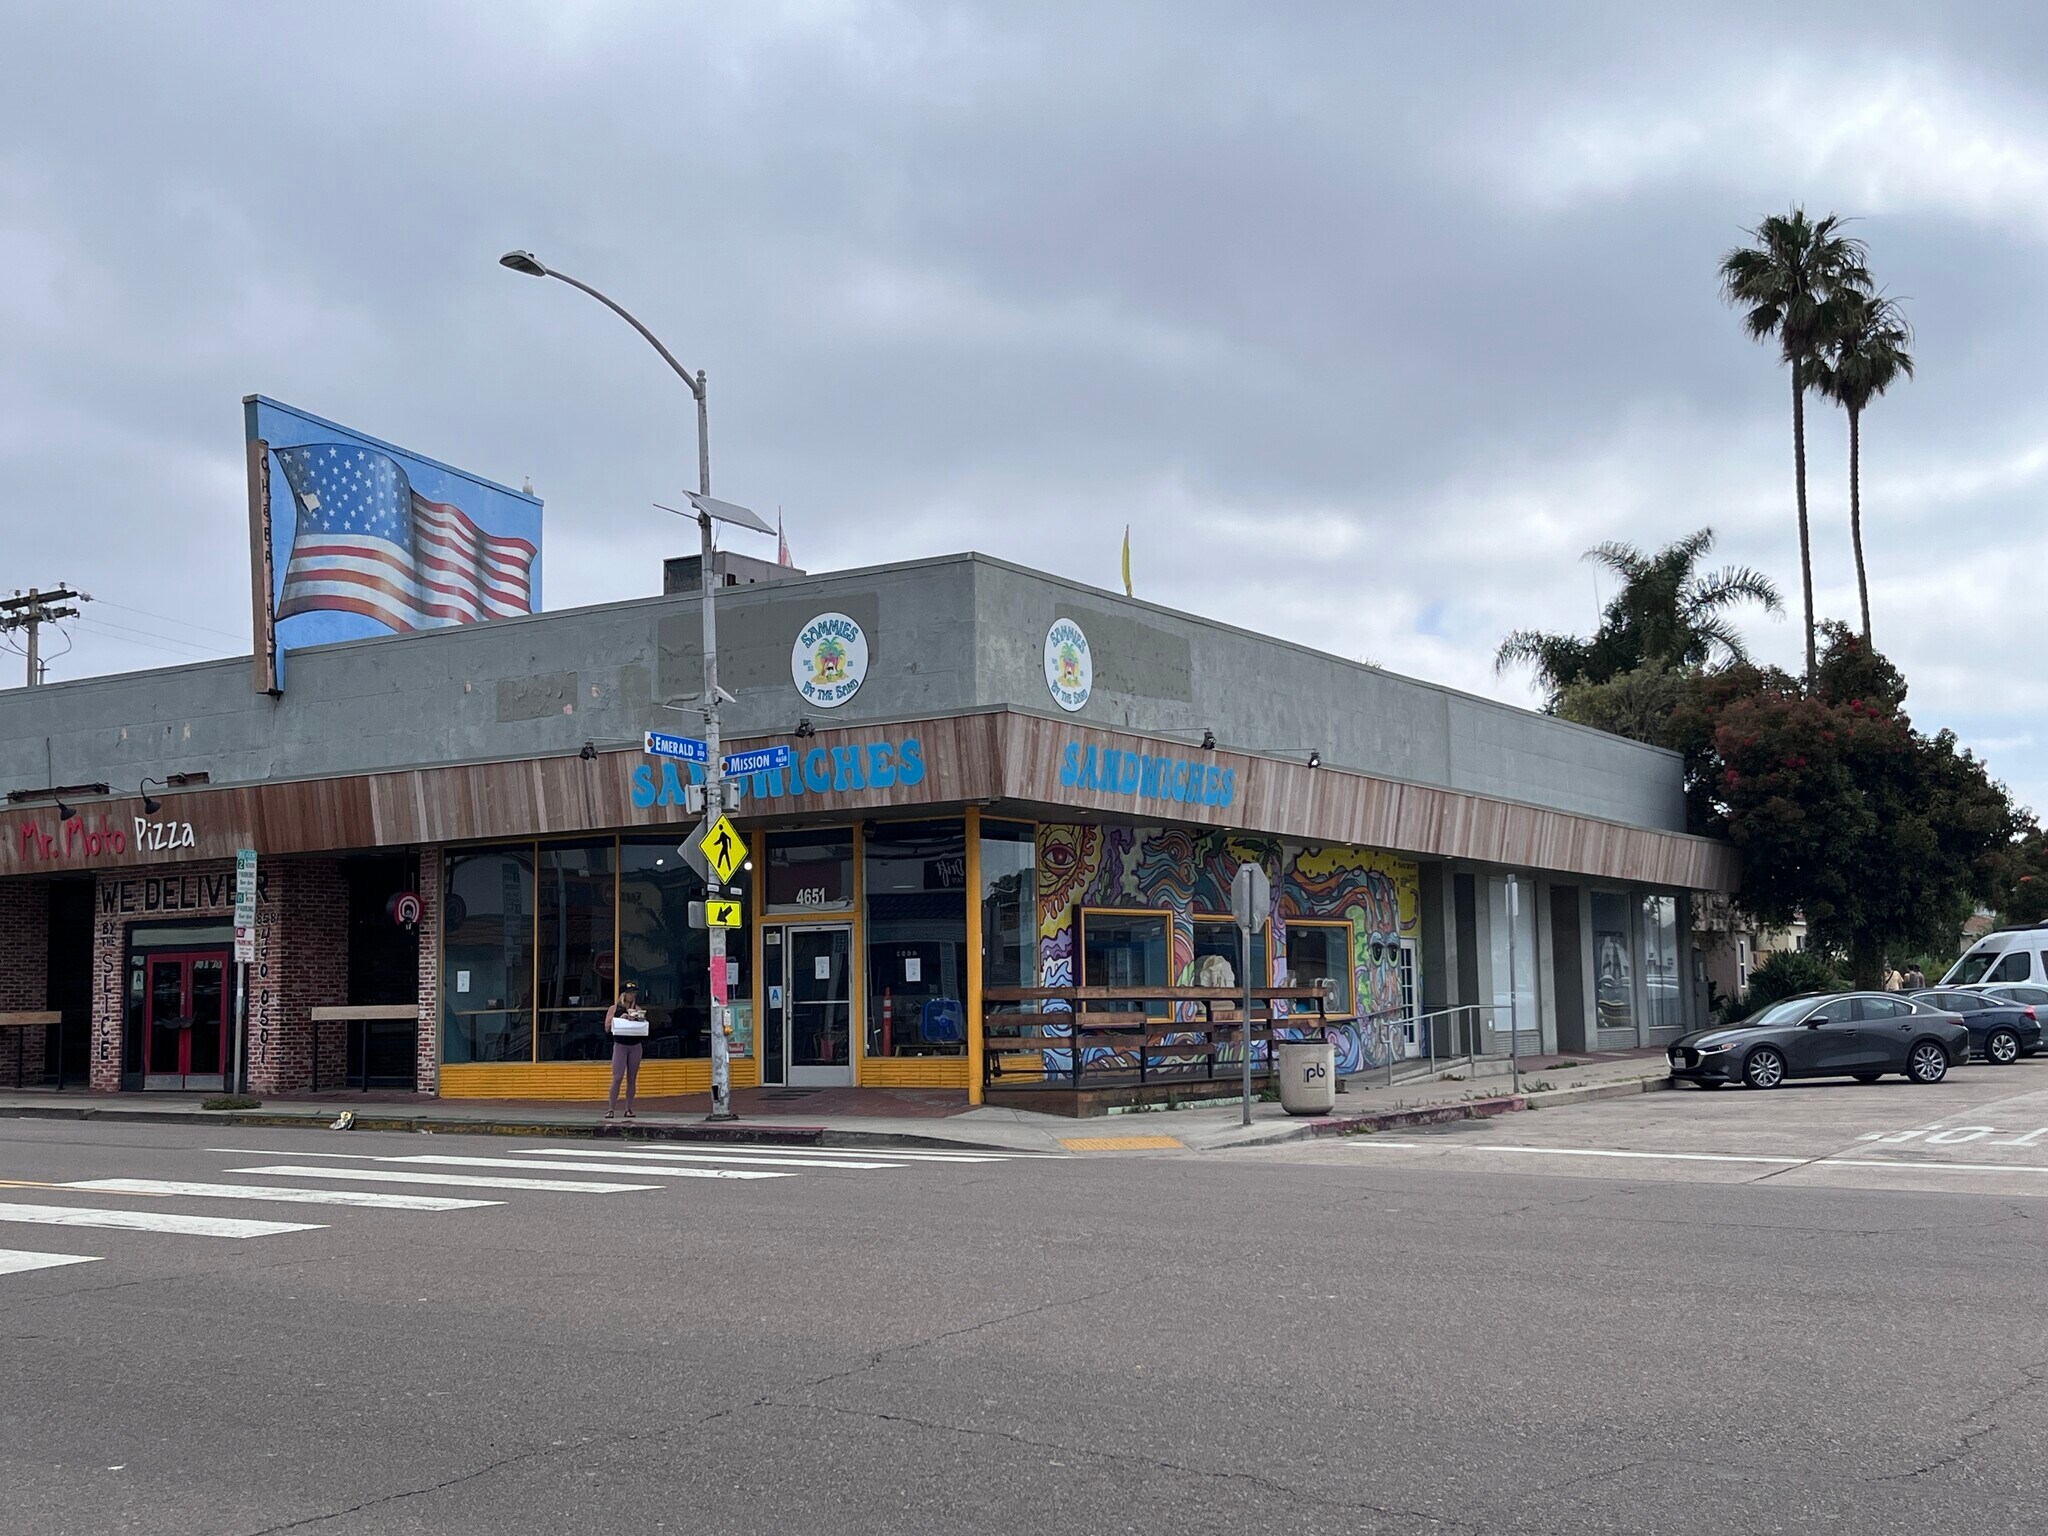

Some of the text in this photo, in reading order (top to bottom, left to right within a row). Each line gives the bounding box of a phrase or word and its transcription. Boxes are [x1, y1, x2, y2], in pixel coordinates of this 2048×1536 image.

[801, 619, 859, 648] SAMMIES
[1050, 625, 1086, 654] SAMMIES
[801, 678, 859, 701] BY THE SAND
[1051, 679, 1088, 704] BY THE SAND
[655, 736, 694, 757] EMERALD
[630, 738, 926, 809] SAWICHES
[730, 754, 770, 773] MISSION
[1060, 740, 1235, 809] SANDWICHES
[19, 814, 195, 862] Mr. Moto Pizza
[100, 869, 270, 914] WE DELIVER
[796, 887, 826, 905] 4651
[102, 921, 117, 935] BY
[100, 936, 117, 947] THE
[100, 952, 115, 1061] SLICE
[771, 988, 780, 1001] A
[1854, 1124, 2048, 1147] TOP
